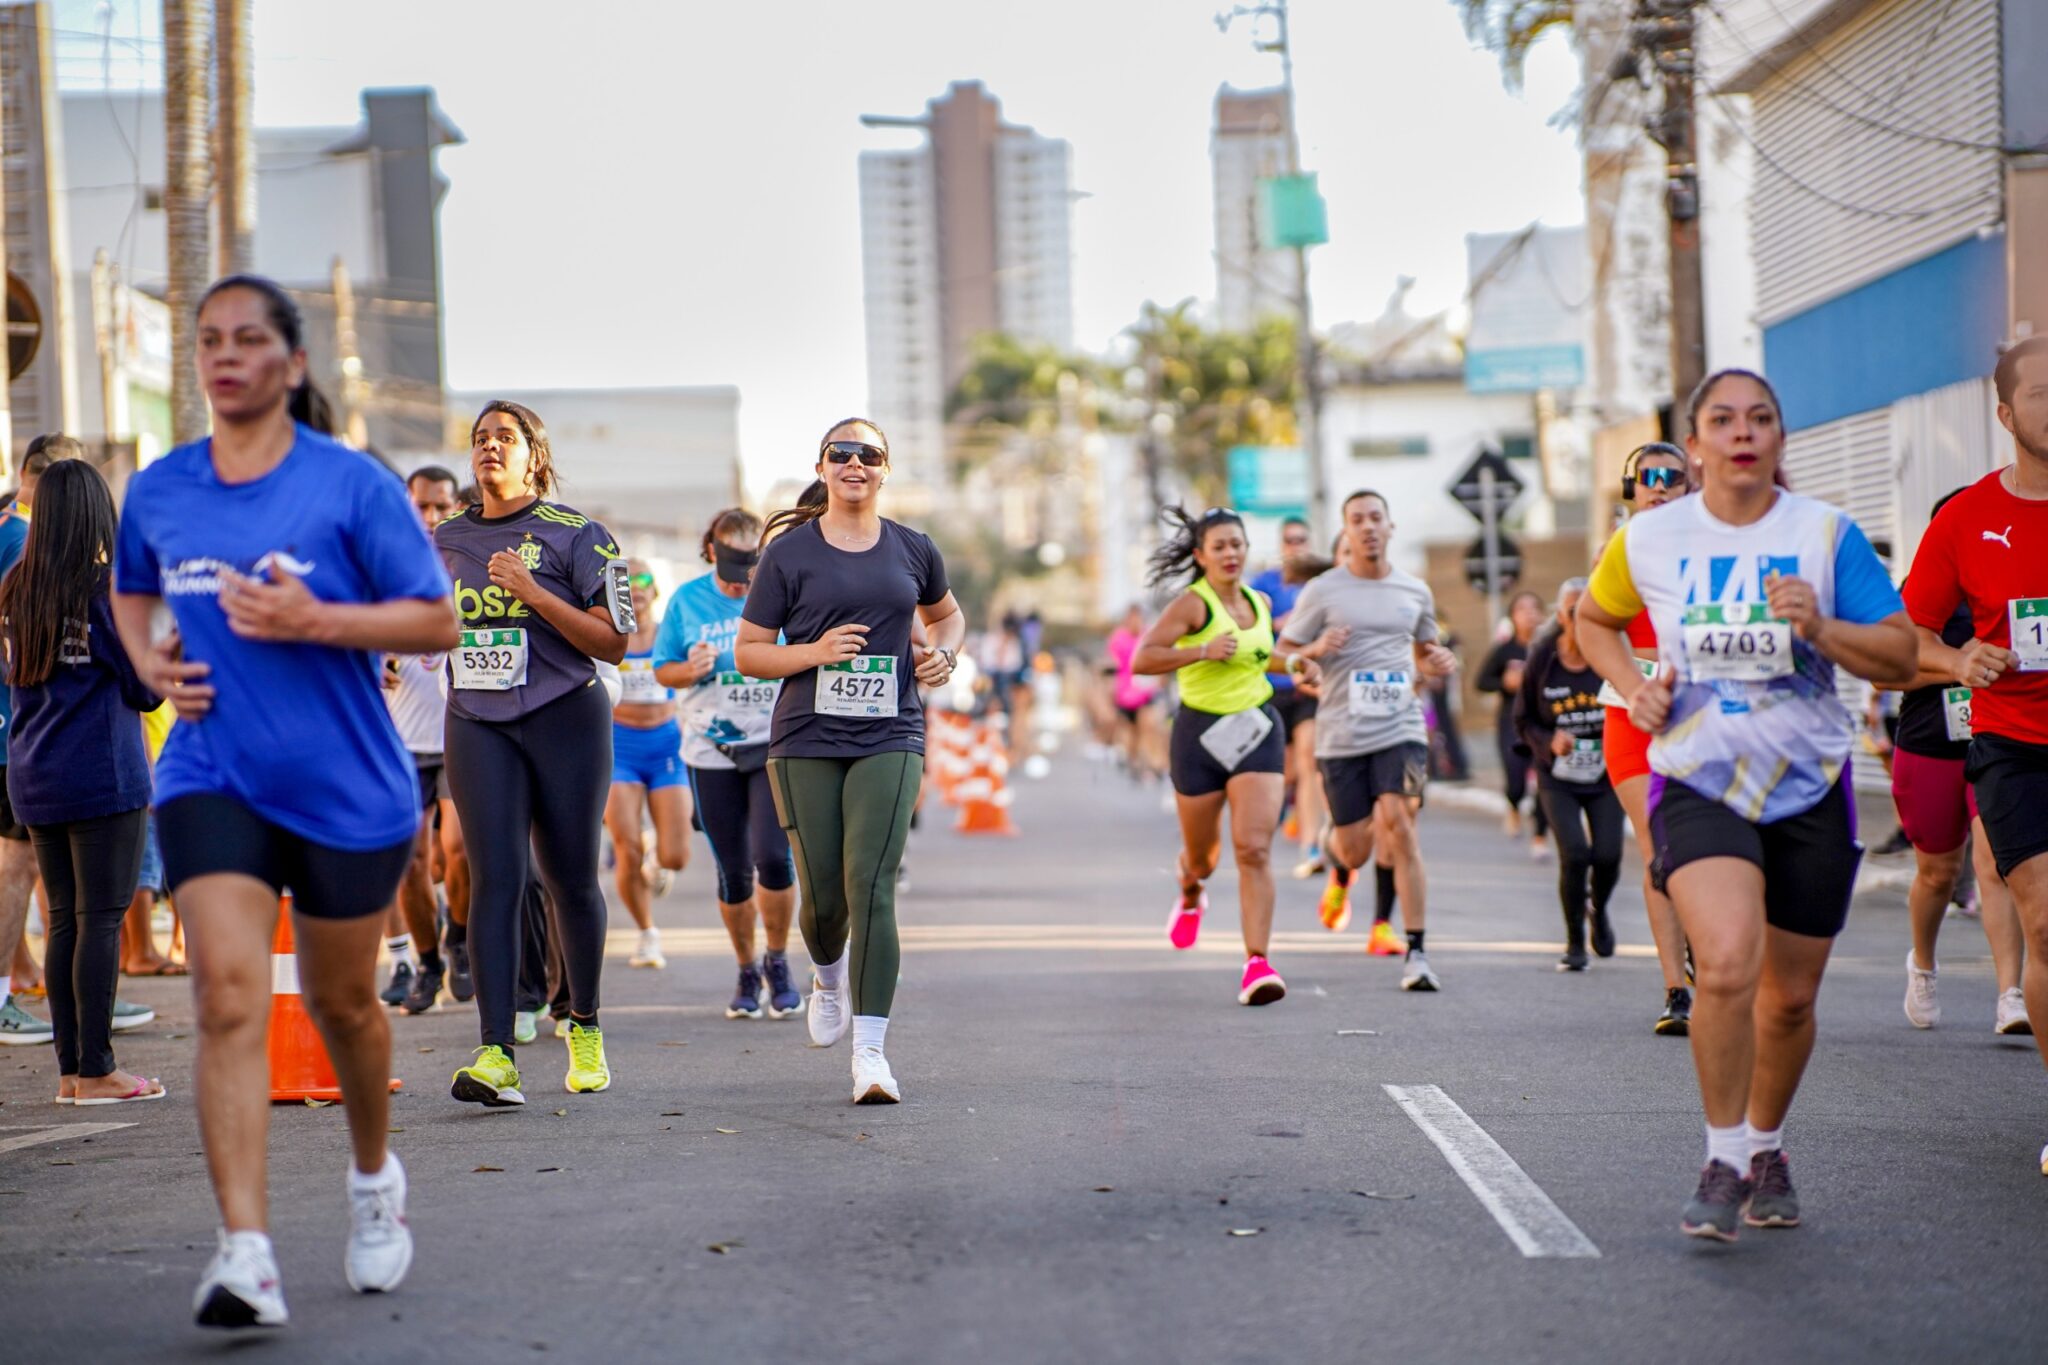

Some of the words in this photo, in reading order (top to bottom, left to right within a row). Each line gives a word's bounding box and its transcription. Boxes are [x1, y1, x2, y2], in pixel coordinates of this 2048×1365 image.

[1700, 631, 1777, 656] 4703
[463, 651, 513, 670] 5332
[728, 686, 774, 703] 4459
[830, 676, 885, 698] 4572
